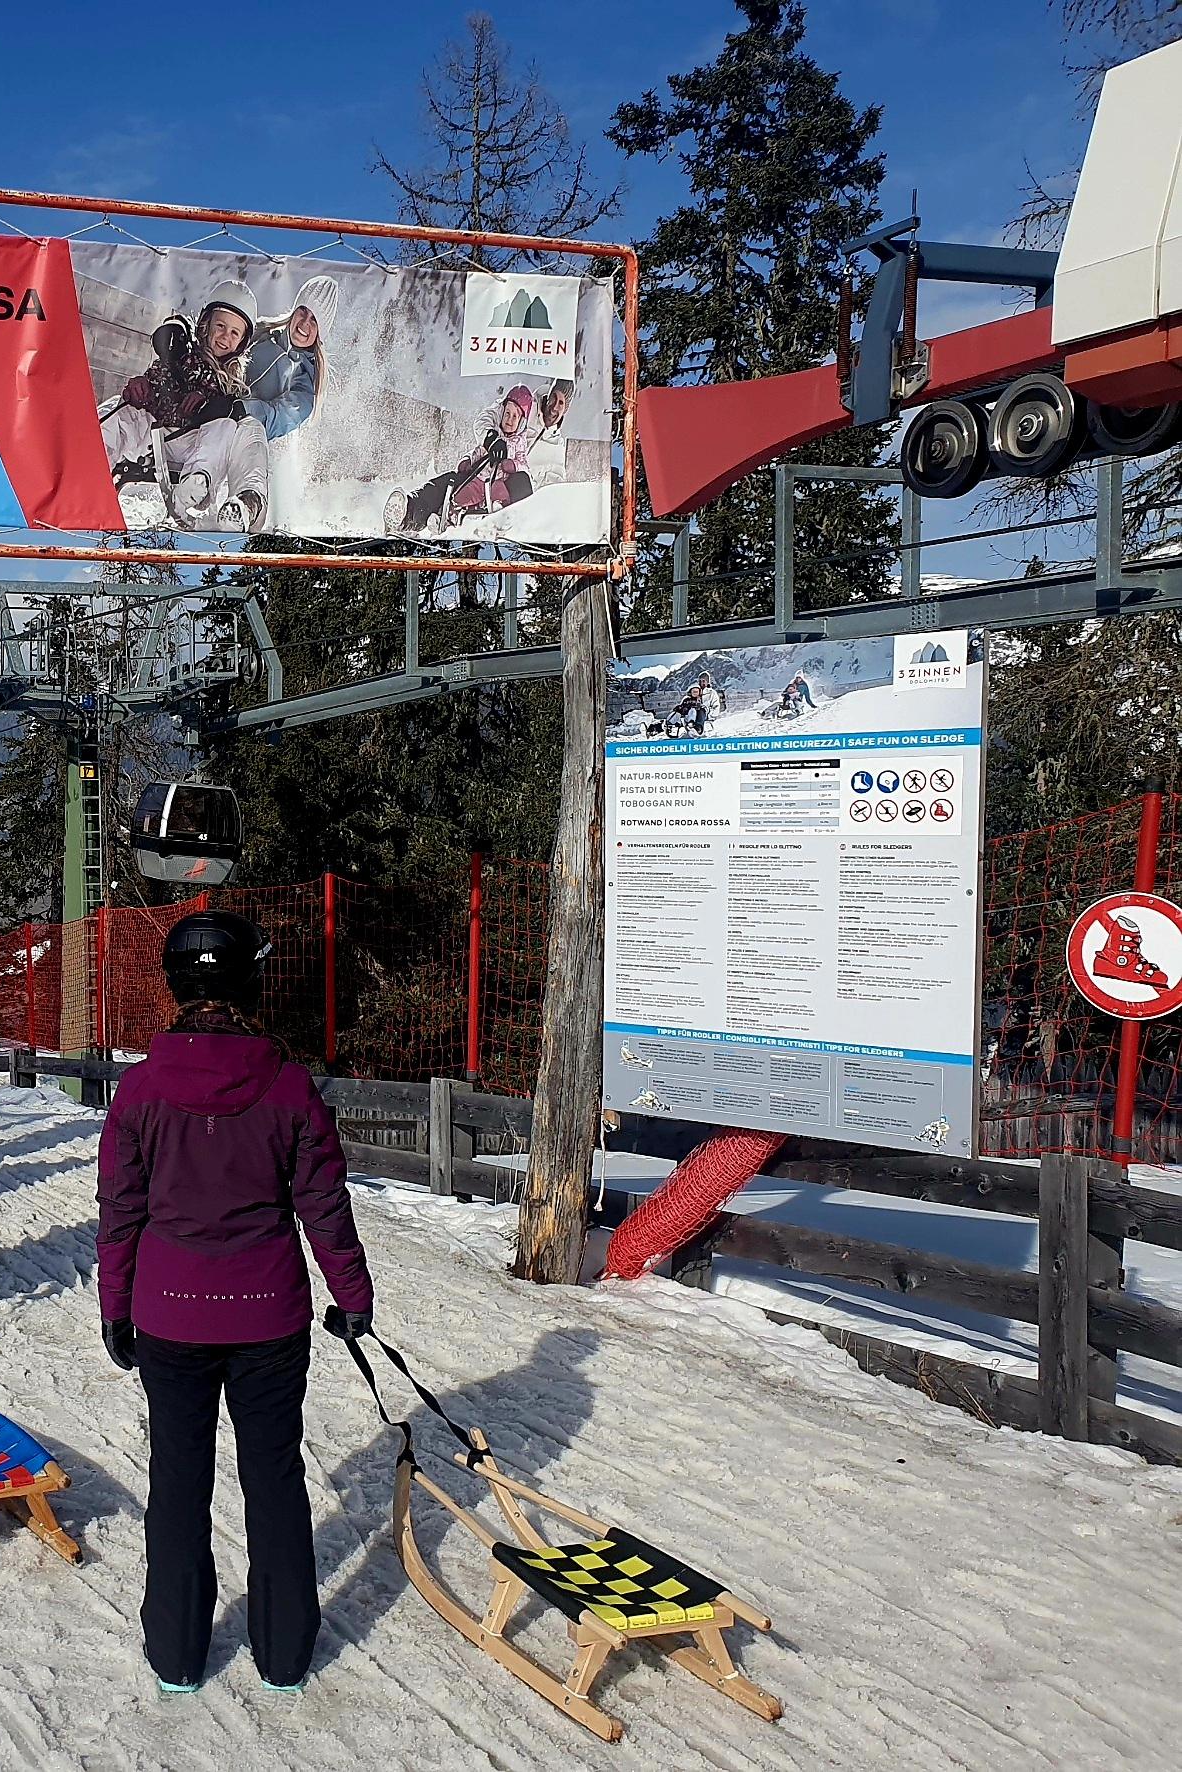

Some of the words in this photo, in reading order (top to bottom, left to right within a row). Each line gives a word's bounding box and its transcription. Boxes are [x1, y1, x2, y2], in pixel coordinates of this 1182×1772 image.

[485, 337, 568, 355] ZINNEN
[486, 357, 550, 366] DOLOMITES
[908, 666, 961, 678] ZINNEN
[615, 746, 649, 755] SICHER
[650, 744, 687, 754] RODELN
[693, 743, 724, 752] SULLO
[725, 742, 770, 751] SLITTINO
[771, 741, 783, 750] IN
[782, 738, 841, 749] SICUREZZA
[847, 737, 876, 747] SAFE
[877, 736, 897, 746] FUN
[901, 735, 918, 745] ON
[919, 734, 965, 744] SLEDGE
[620, 771, 714, 781] NATUR-RODELBAHN
[620, 786, 646, 794] PISTA
[647, 786, 657, 794] DI
[659, 785, 702, 794] SLITTINO
[620, 799, 673, 808] TOBOGGAN
[674, 799, 695, 807] RUN
[620, 819, 663, 827] ROTWAND
[657, 1028, 677, 1036] TIPPS
[692, 1031, 721, 1040] RODLER
[761, 1037, 777, 1046] PER
[826, 1043, 843, 1052] TIPS
[843, 1045, 860, 1054] FOR
